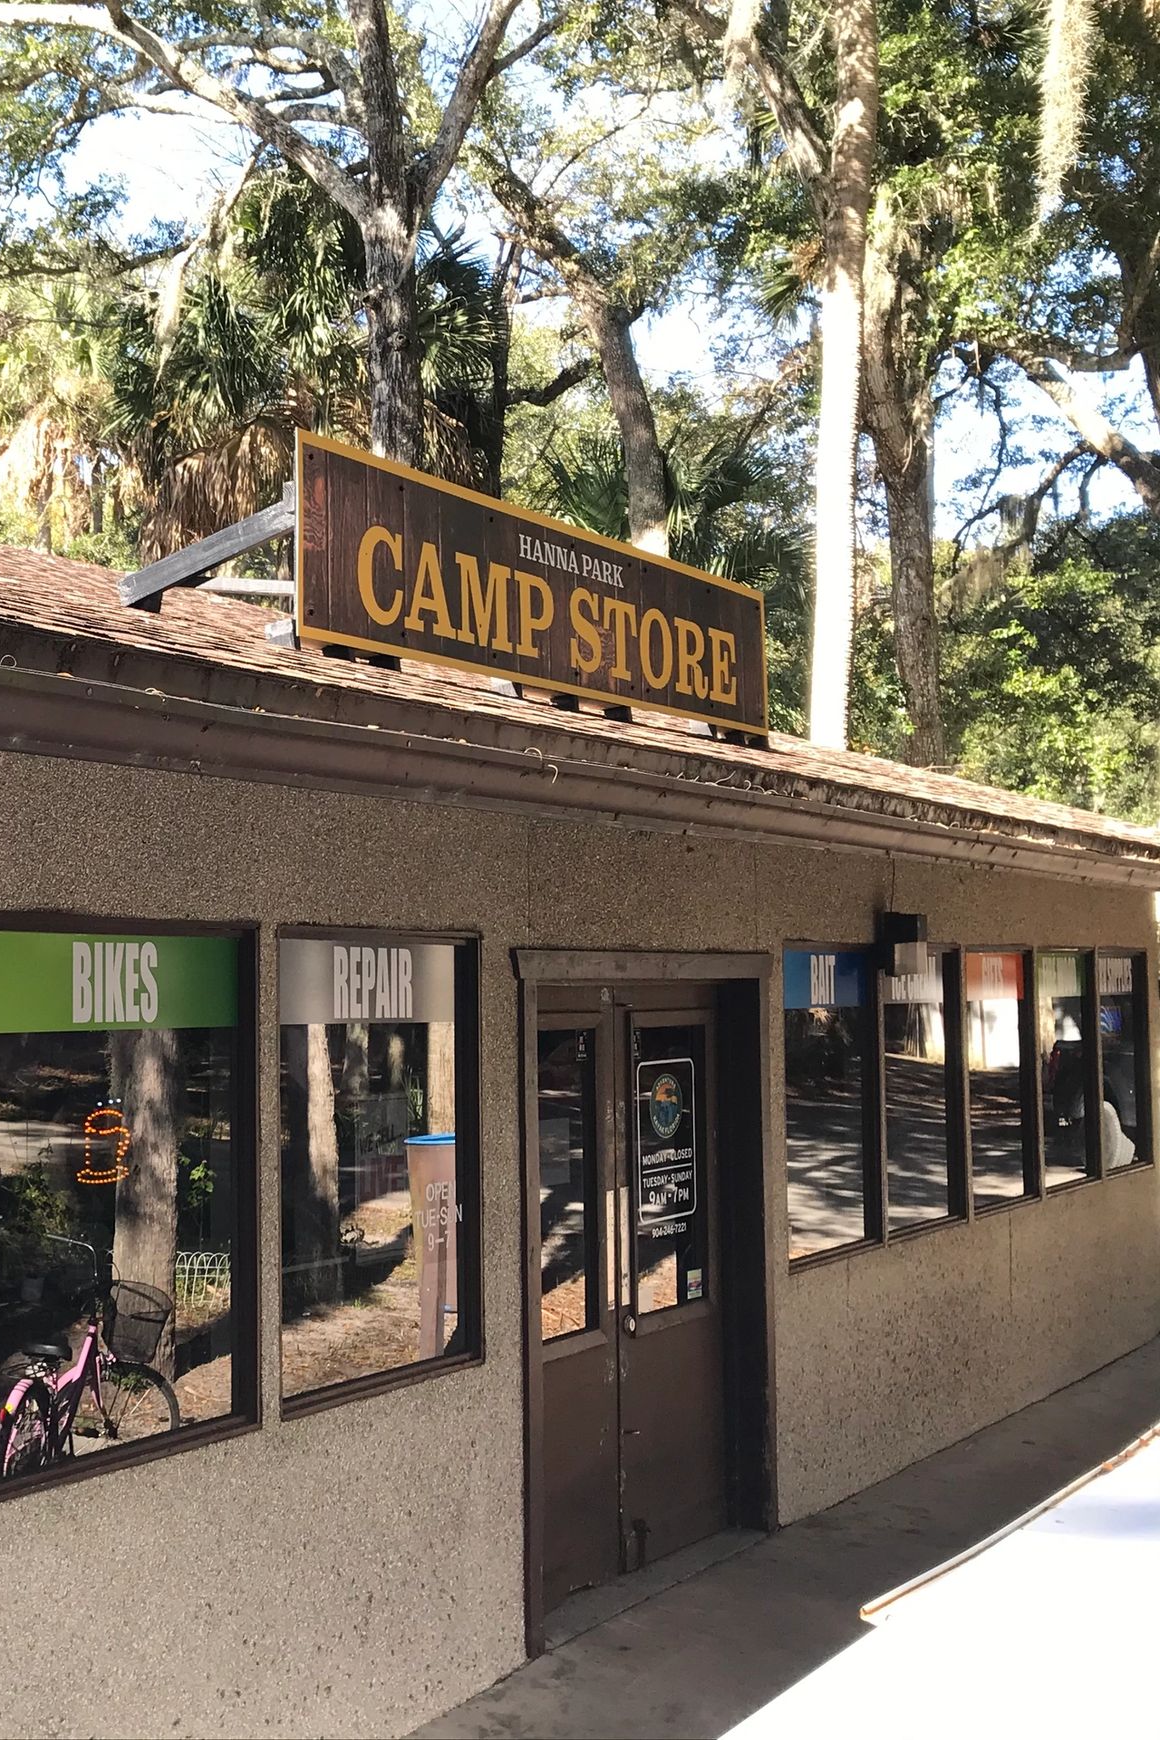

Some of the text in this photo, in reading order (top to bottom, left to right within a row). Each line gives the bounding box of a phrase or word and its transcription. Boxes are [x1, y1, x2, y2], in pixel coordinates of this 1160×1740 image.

[519, 533, 624, 588] HANNA PARK
[357, 525, 738, 706] CAMP STORE
[72, 941, 159, 1024] BIKES
[333, 945, 413, 1020] REPAIR
[810, 954, 836, 1005] BAIT
[426, 1181, 457, 1202] OPEN
